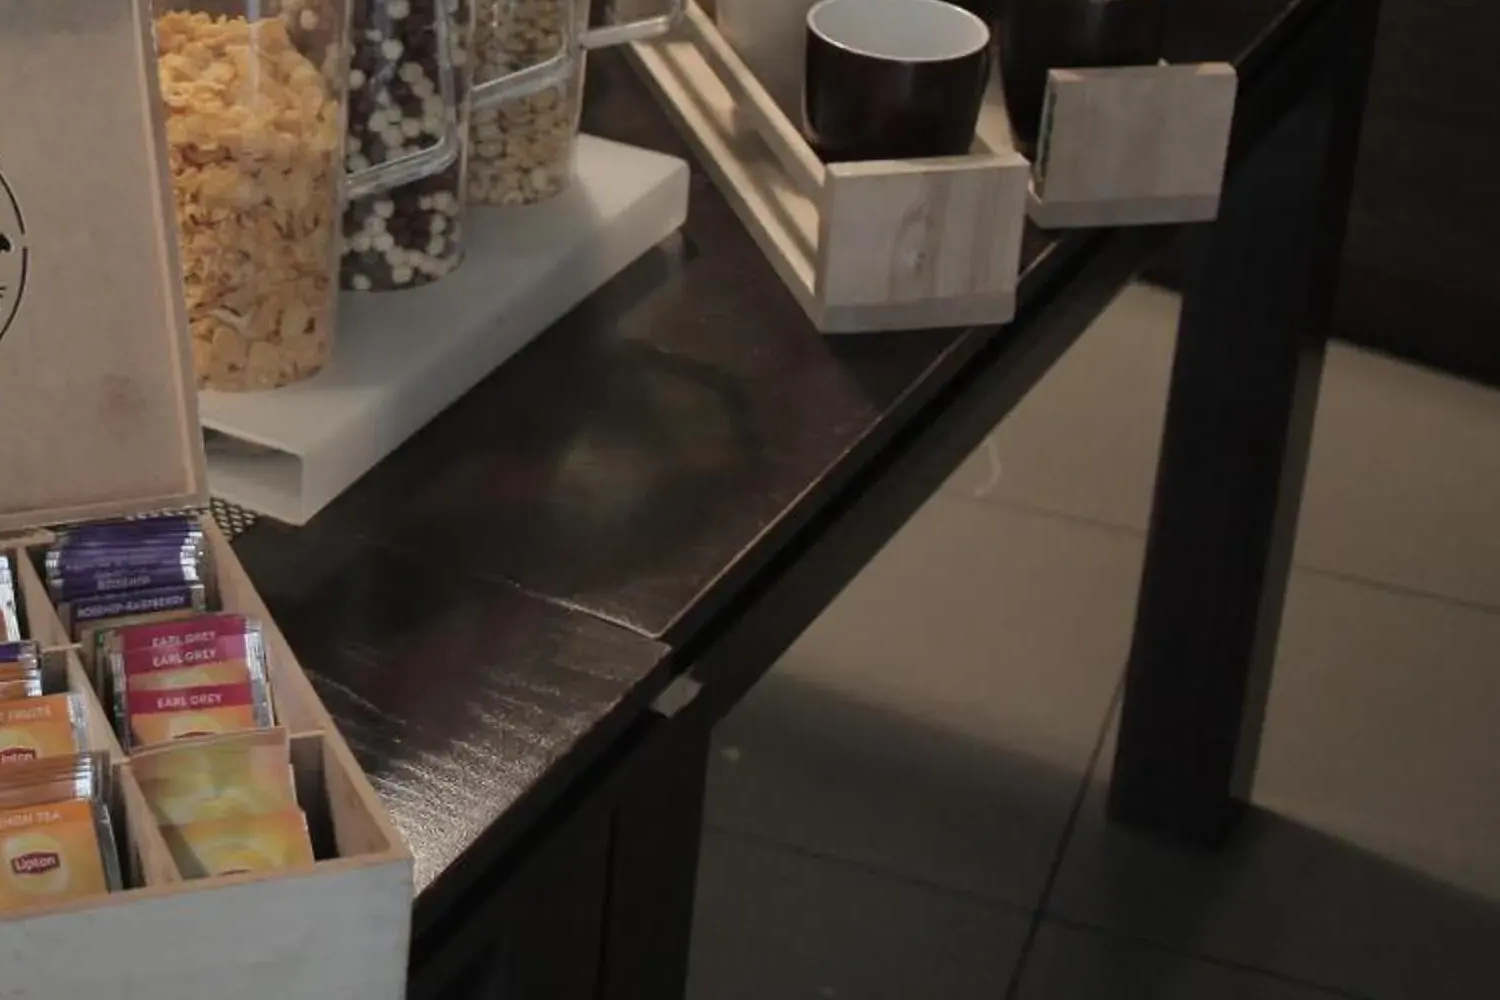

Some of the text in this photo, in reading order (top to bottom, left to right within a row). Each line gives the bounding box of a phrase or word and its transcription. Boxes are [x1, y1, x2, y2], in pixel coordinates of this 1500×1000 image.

[152, 631, 216, 648] EARL GREY
[152, 649, 216, 668] EARL GREY
[156, 693, 222, 709] EARL GREY
[8, 705, 53, 722] FRUITS
[36, 809, 62, 823] TEA
[14, 854, 56, 873] Lipton
